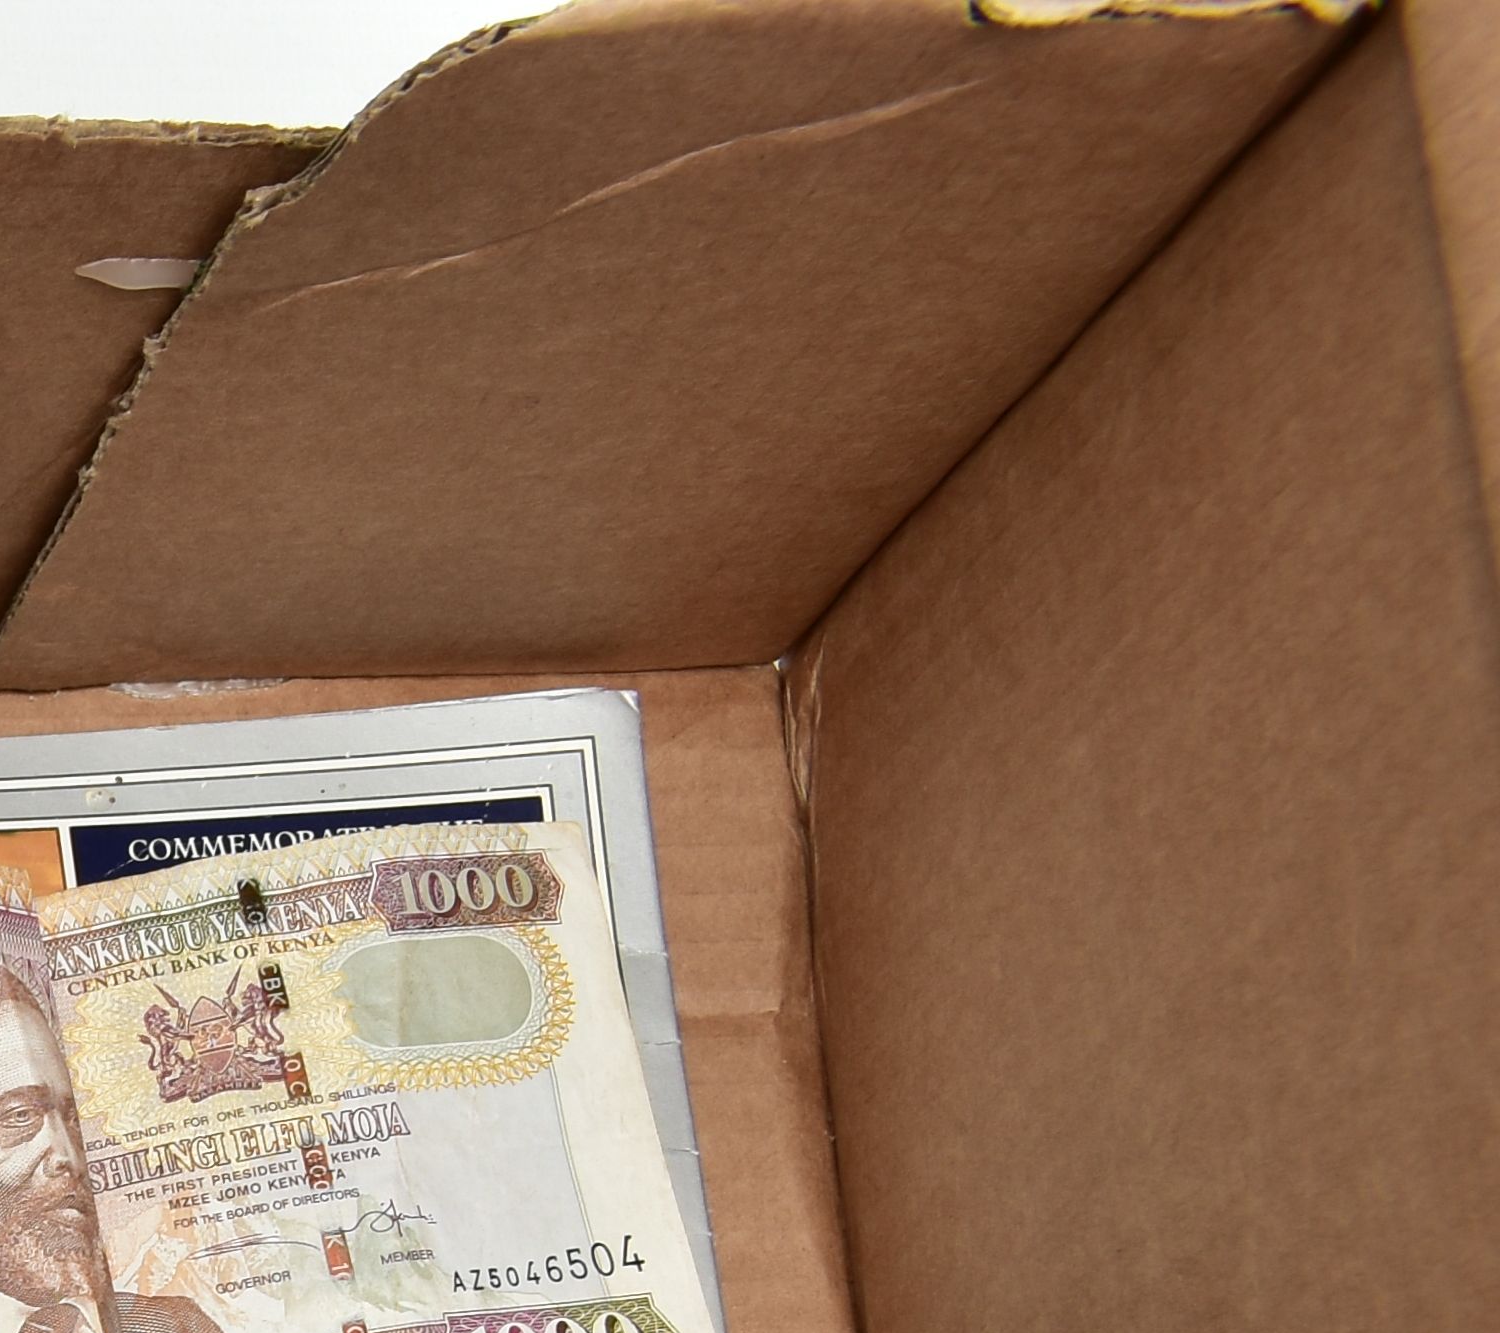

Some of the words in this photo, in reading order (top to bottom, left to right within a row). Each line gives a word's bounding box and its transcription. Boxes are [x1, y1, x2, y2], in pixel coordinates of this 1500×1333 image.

[395, 861, 538, 917] 1000
[50, 933, 133, 981] ANKI
[137, 912, 206, 959] KUU
[207, 909, 252, 944] YA
[263, 890, 366, 935] KENYA
[68, 963, 165, 996] CENTRAL
[171, 948, 228, 977] BANK
[234, 942, 261, 959] OF
[267, 932, 336, 954] KENYA
[86, 1136, 120, 1152] EGAL
[123, 1123, 176, 1142] TENDER
[183, 1115, 210, 1127] FOR
[216, 1108, 245, 1122] ONE
[250, 1094, 324, 1116] THOUSAND
[329, 1082, 396, 1102] SHILLINGS
[87, 1132, 231, 1194] SHILINGI
[231, 1115, 314, 1162] ELFU
[323, 1102, 411, 1146] MOJA
[124, 1189, 156, 1204] THE
[161, 1178, 204, 1196] FIRST
[211, 1159, 298, 1185] PRESIDENT
[331, 1147, 381, 1164] KENYA
[168, 1192, 210, 1210] MZEE
[216, 1182, 262, 1202] JOMO
[174, 1216, 198, 1230] FOR
[202, 1210, 223, 1224] THE
[226, 1202, 269, 1220] BOARD
[272, 1199, 290, 1211] OF
[292, 1187, 360, 1208] DIRECTORS
[215, 1271, 291, 1295] GOVERNOR
[381, 1248, 435, 1265] MEMBER
[452, 1235, 646, 1294] AZ5046504
